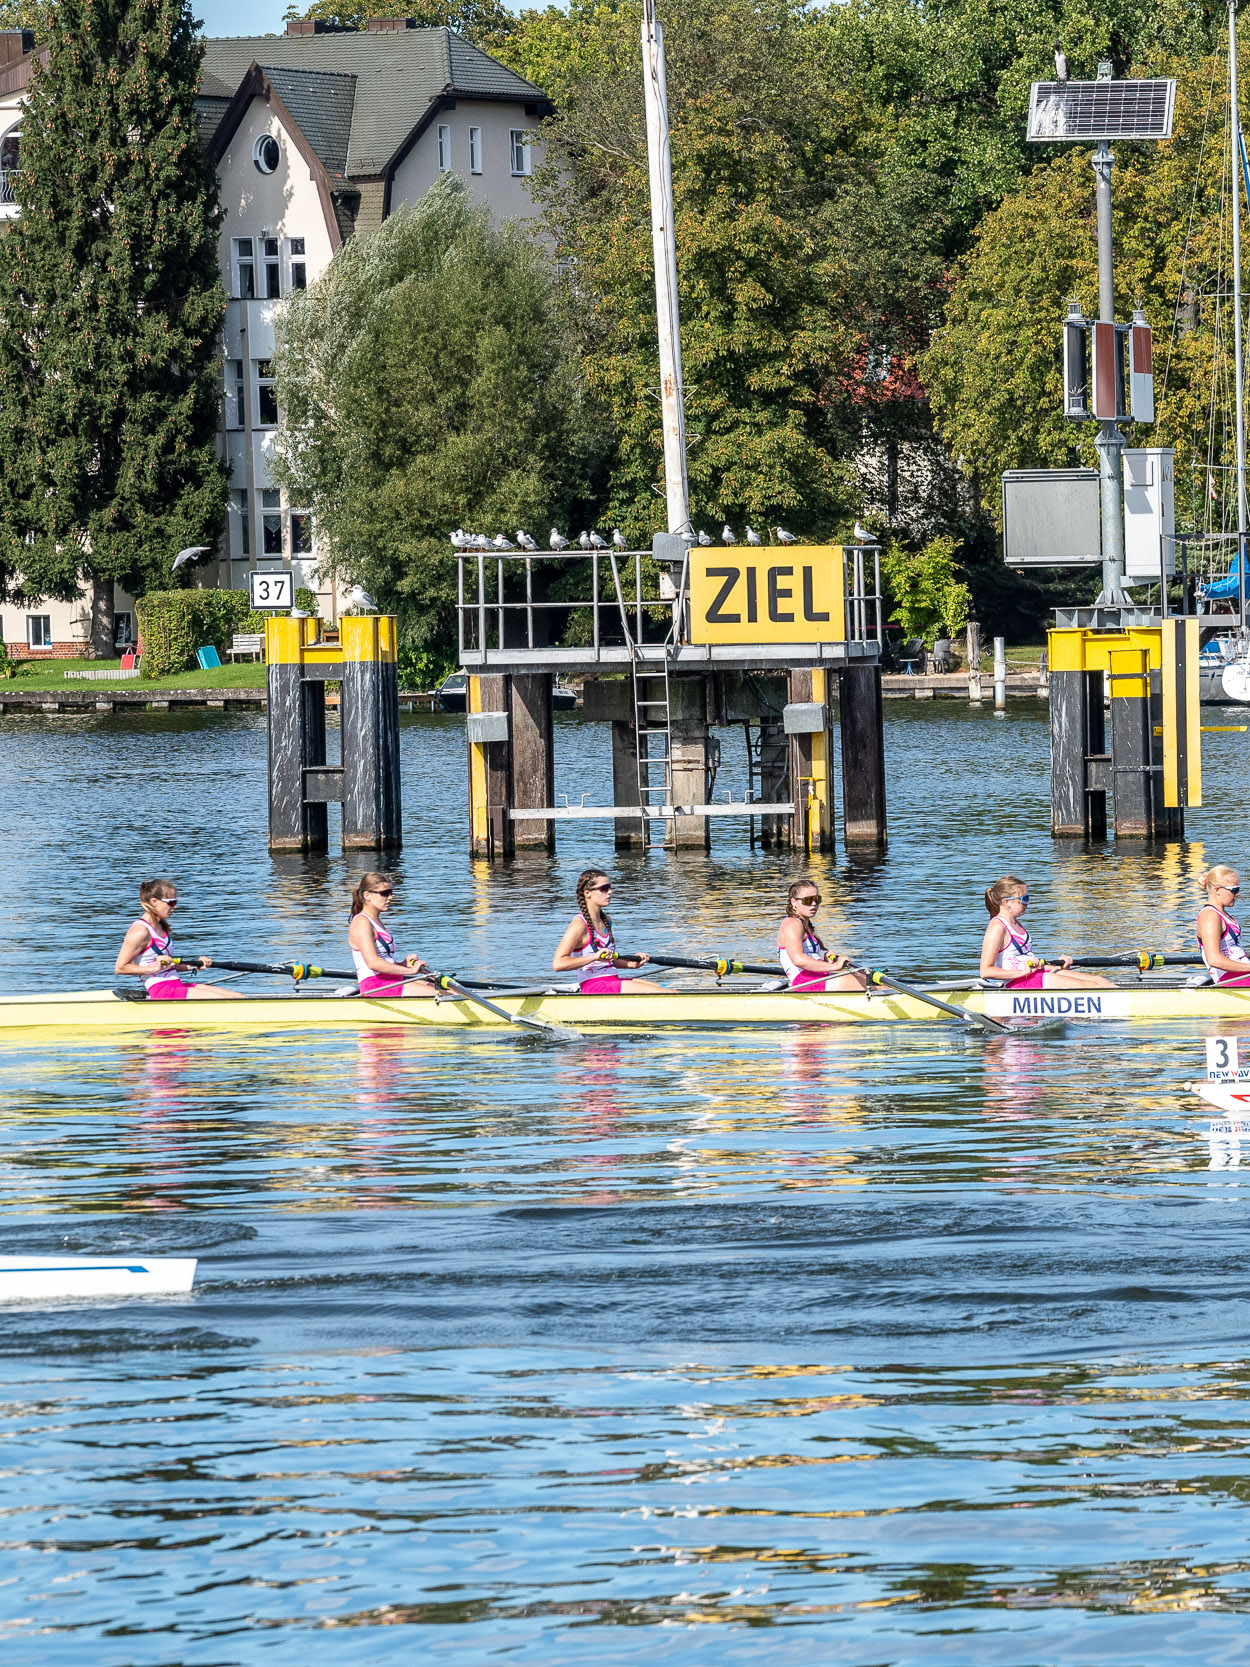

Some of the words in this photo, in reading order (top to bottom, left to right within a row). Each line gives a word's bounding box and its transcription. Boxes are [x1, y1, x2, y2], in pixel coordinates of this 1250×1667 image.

[258, 580, 285, 600] 37
[705, 566, 830, 623] ZIEL
[1013, 996, 1102, 1014] MINDEN
[1215, 1039, 1229, 1069] 3
